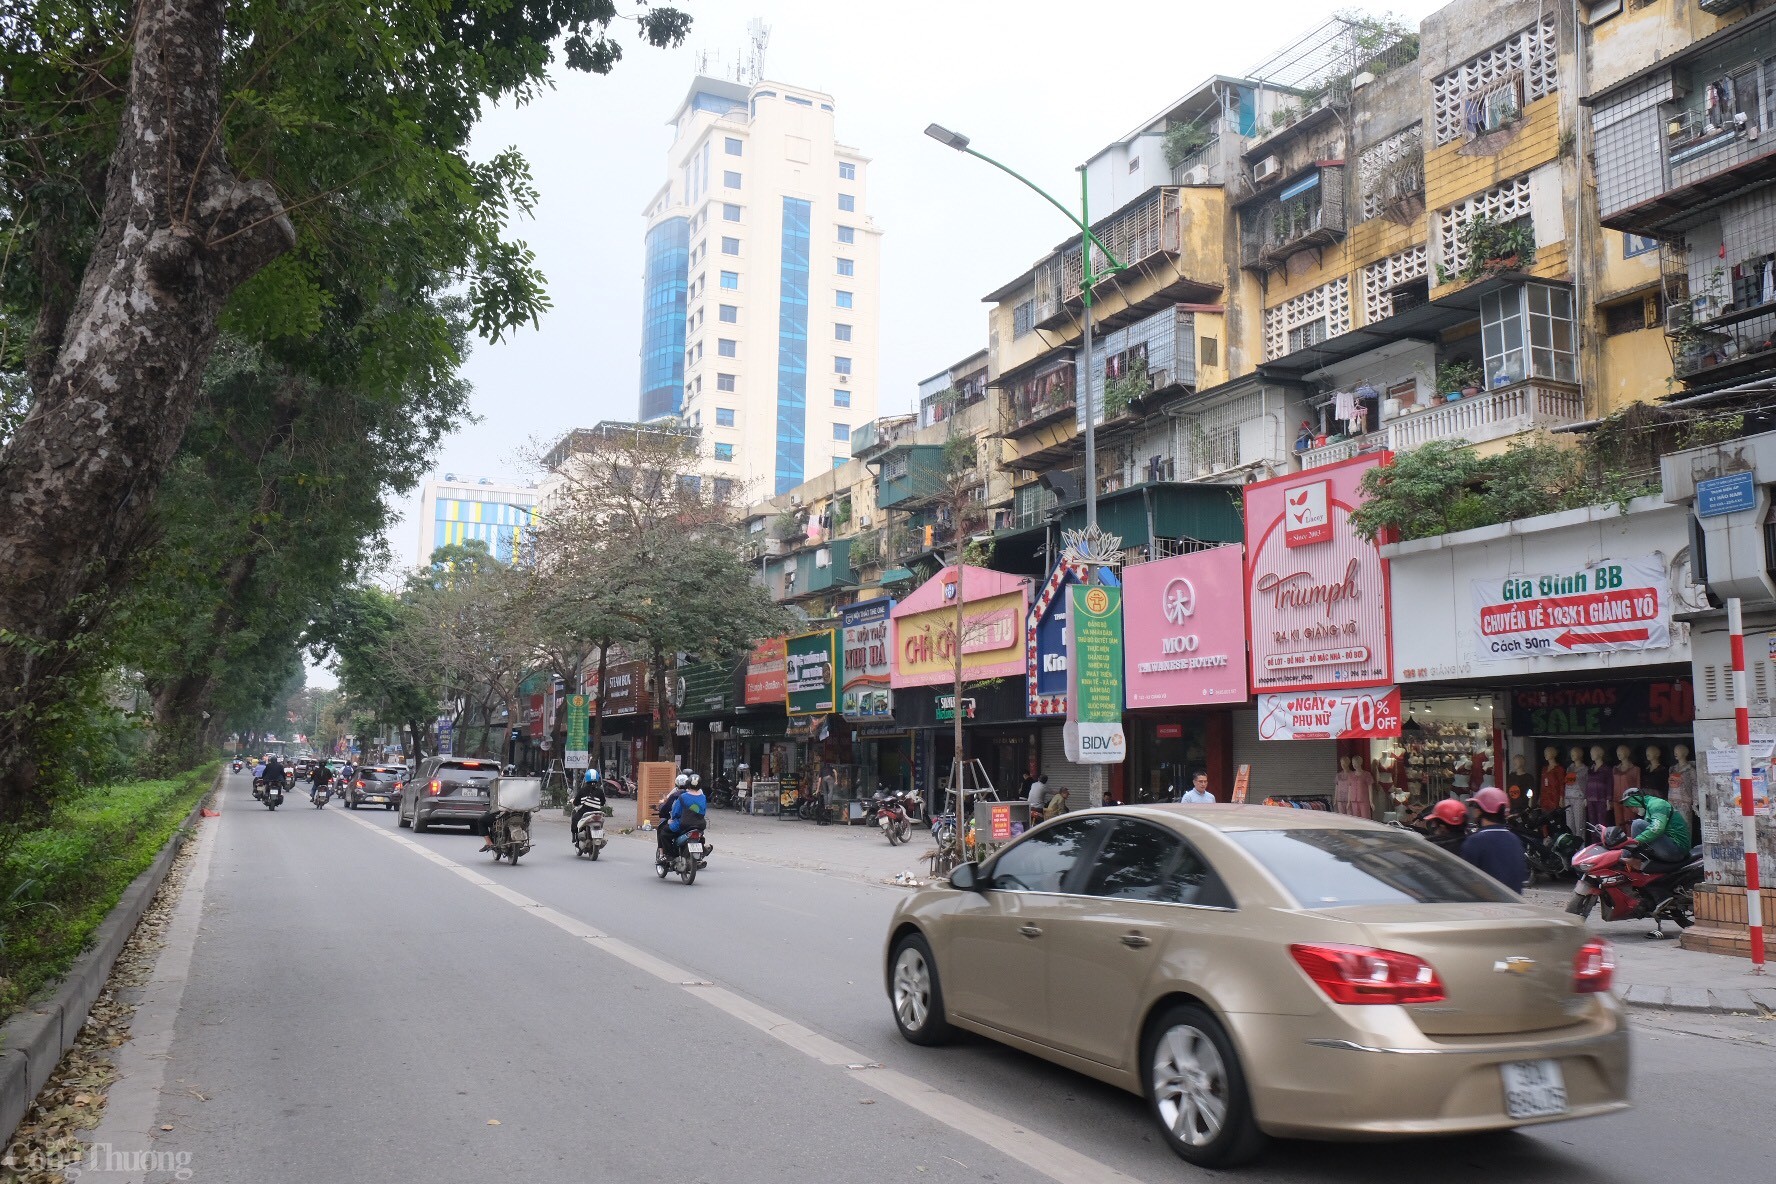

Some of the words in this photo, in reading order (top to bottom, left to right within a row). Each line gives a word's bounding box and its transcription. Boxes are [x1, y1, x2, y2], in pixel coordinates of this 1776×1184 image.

[1729, 491, 1743, 499] NAM
[1293, 531, 1308, 541] Since
[1257, 557, 1361, 617] Triumph
[1502, 579, 1533, 601] Gia
[1595, 565, 1623, 591] BB
[1483, 603, 1527, 634] CHUYỂN
[1528, 602, 1545, 628] VỀ
[1546, 605, 1585, 627] 103K1
[1588, 595, 1632, 623] GIẢNG
[1633, 593, 1655, 618] VÕ
[905, 623, 933, 664] CHẢ
[1161, 634, 1199, 655] MOO
[1491, 637, 1521, 653] Cách
[1525, 637, 1551, 650] 50m
[1189, 654, 1228, 669] HOTPOT
[1295, 691, 1327, 712] NGÀY
[1516, 687, 1619, 708] CHRISTMAS
[1292, 714, 1313, 730] PHỤ
[1315, 710, 1332, 726] NỮ
[1340, 694, 1375, 731] 70
[1376, 700, 1390, 715] %
[1376, 716, 1397, 730] OFF
[1531, 706, 1601, 734] SALE
[1082, 736, 1112, 750] BIDV
